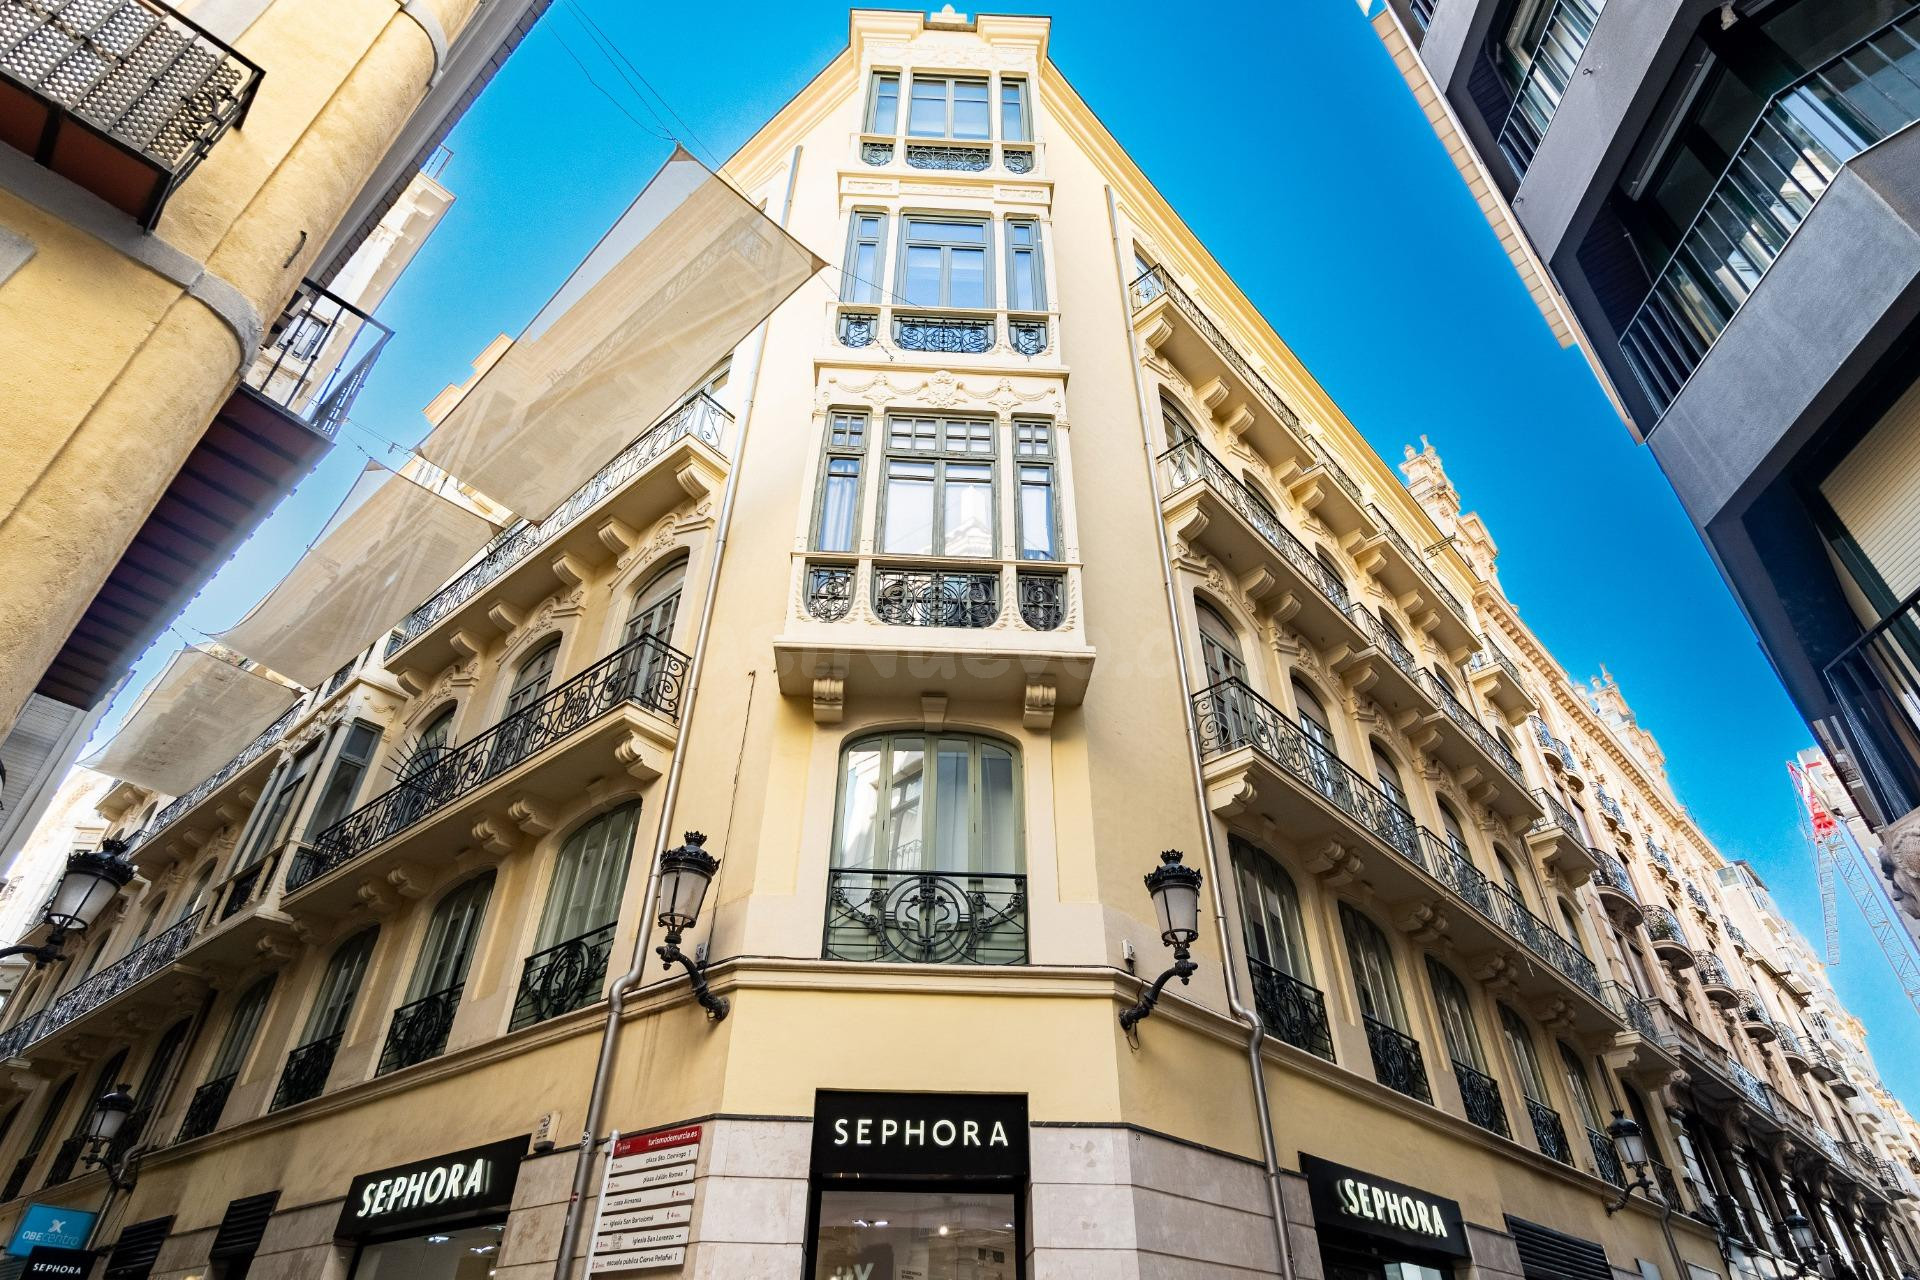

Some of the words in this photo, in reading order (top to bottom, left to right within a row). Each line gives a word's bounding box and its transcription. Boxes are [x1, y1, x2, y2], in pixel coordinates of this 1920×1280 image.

[648, 1131, 697, 1144] turismodemurcia.es
[833, 1118, 1009, 1147] SEPHORA
[356, 1158, 486, 1218] SEPHORA
[1343, 1178, 1449, 1238] SEPHORA
[609, 1219, 623, 1228] iglesia
[623, 1217, 632, 1225] San
[632, 1236, 647, 1246] iglesia
[646, 1234, 656, 1243] San
[622, 1256, 639, 1265] pública
[32, 1262, 82, 1275] SEPHORA
